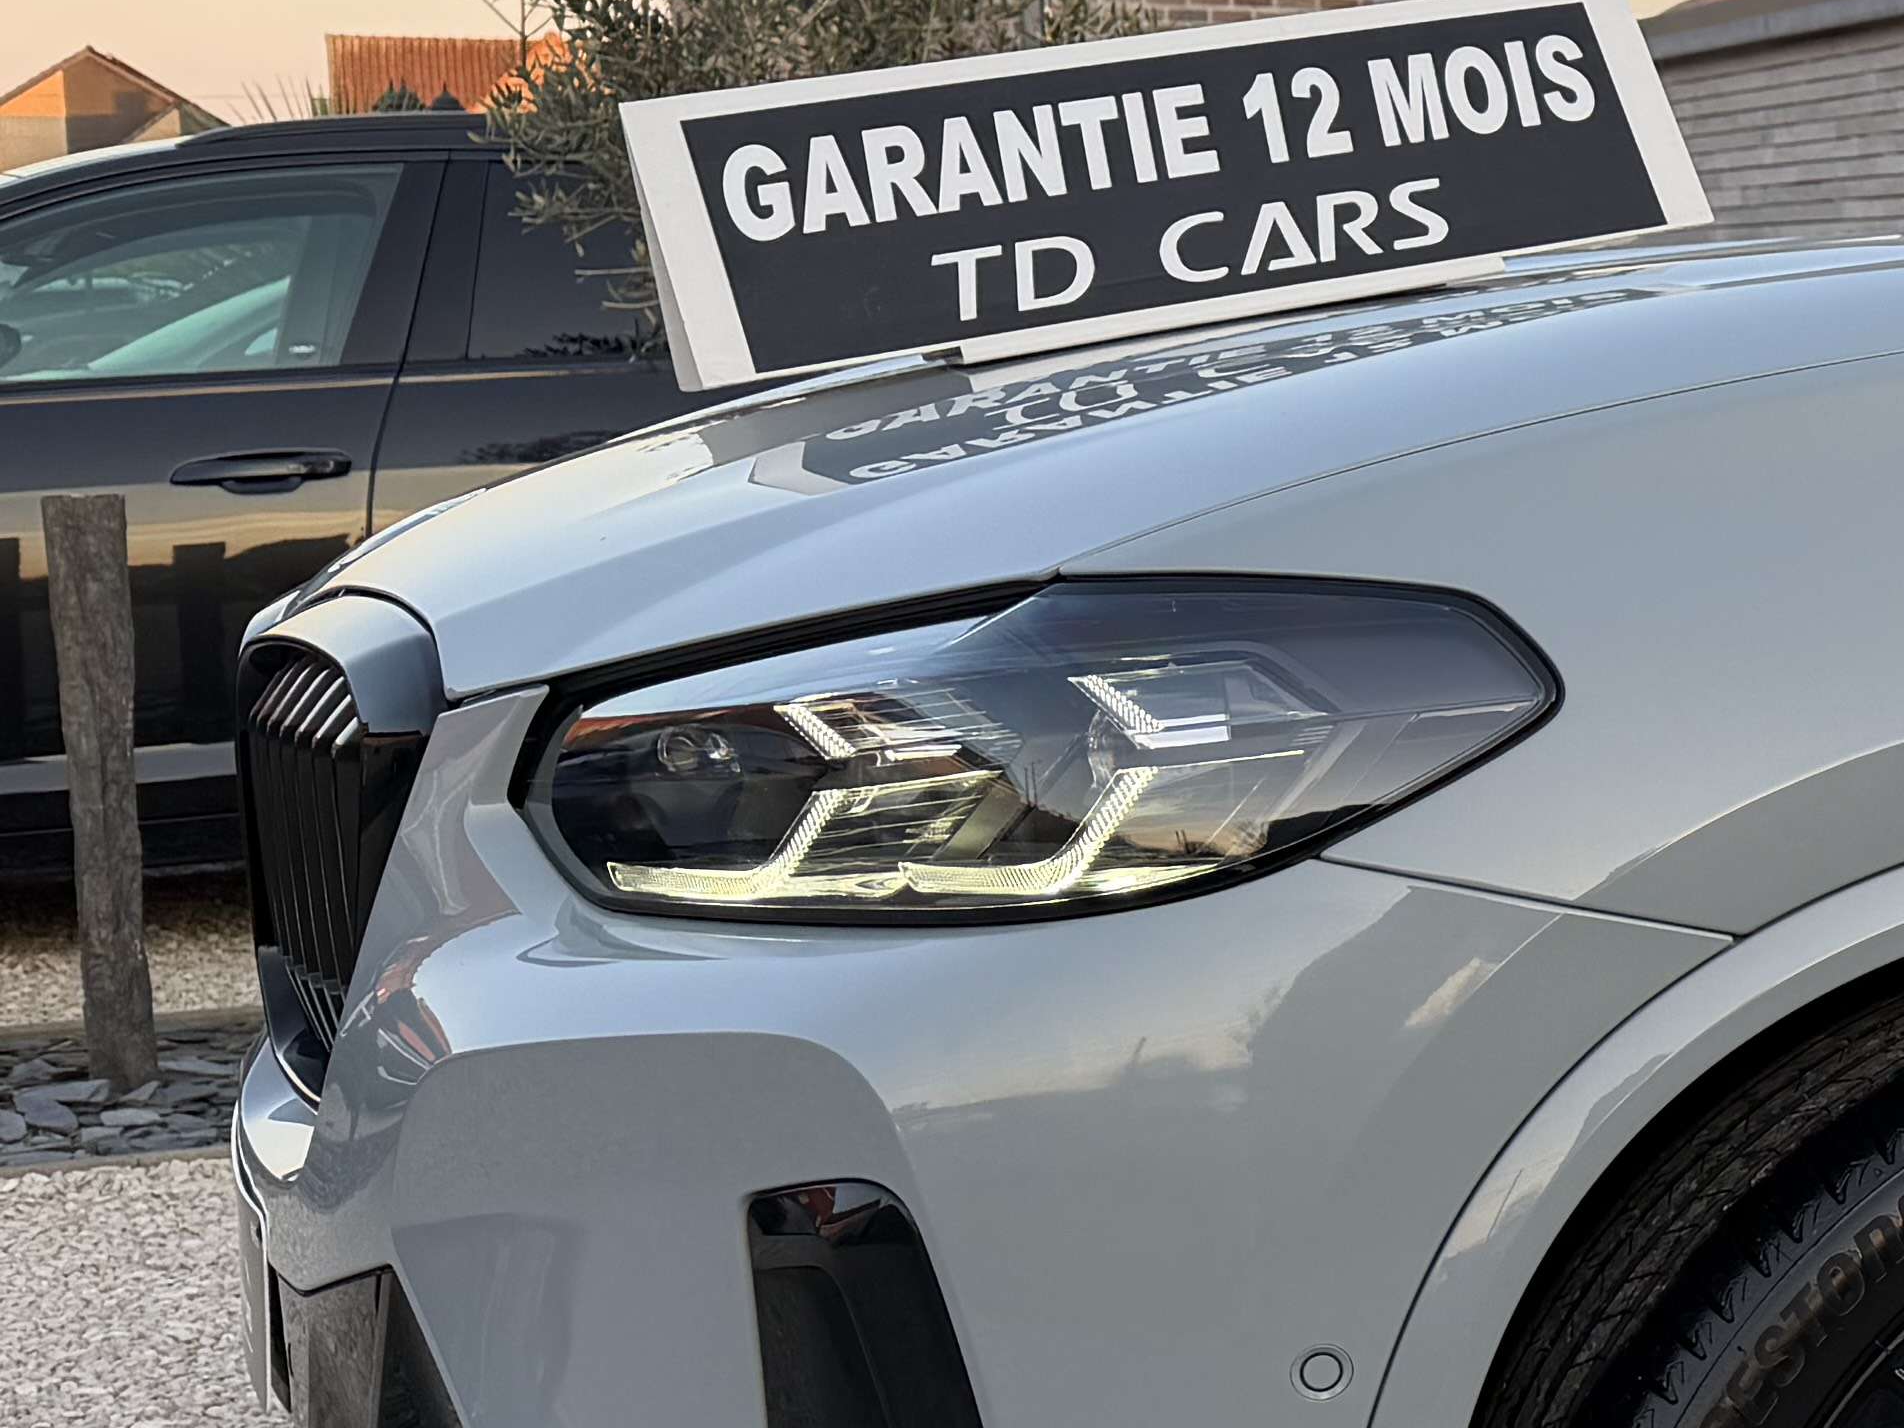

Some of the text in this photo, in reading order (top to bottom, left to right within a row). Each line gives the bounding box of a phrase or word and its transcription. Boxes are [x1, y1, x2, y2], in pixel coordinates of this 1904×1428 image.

[723, 35, 1595, 241] GARANTIE 12 MOIS
[931, 178, 1449, 321] TD CARS
